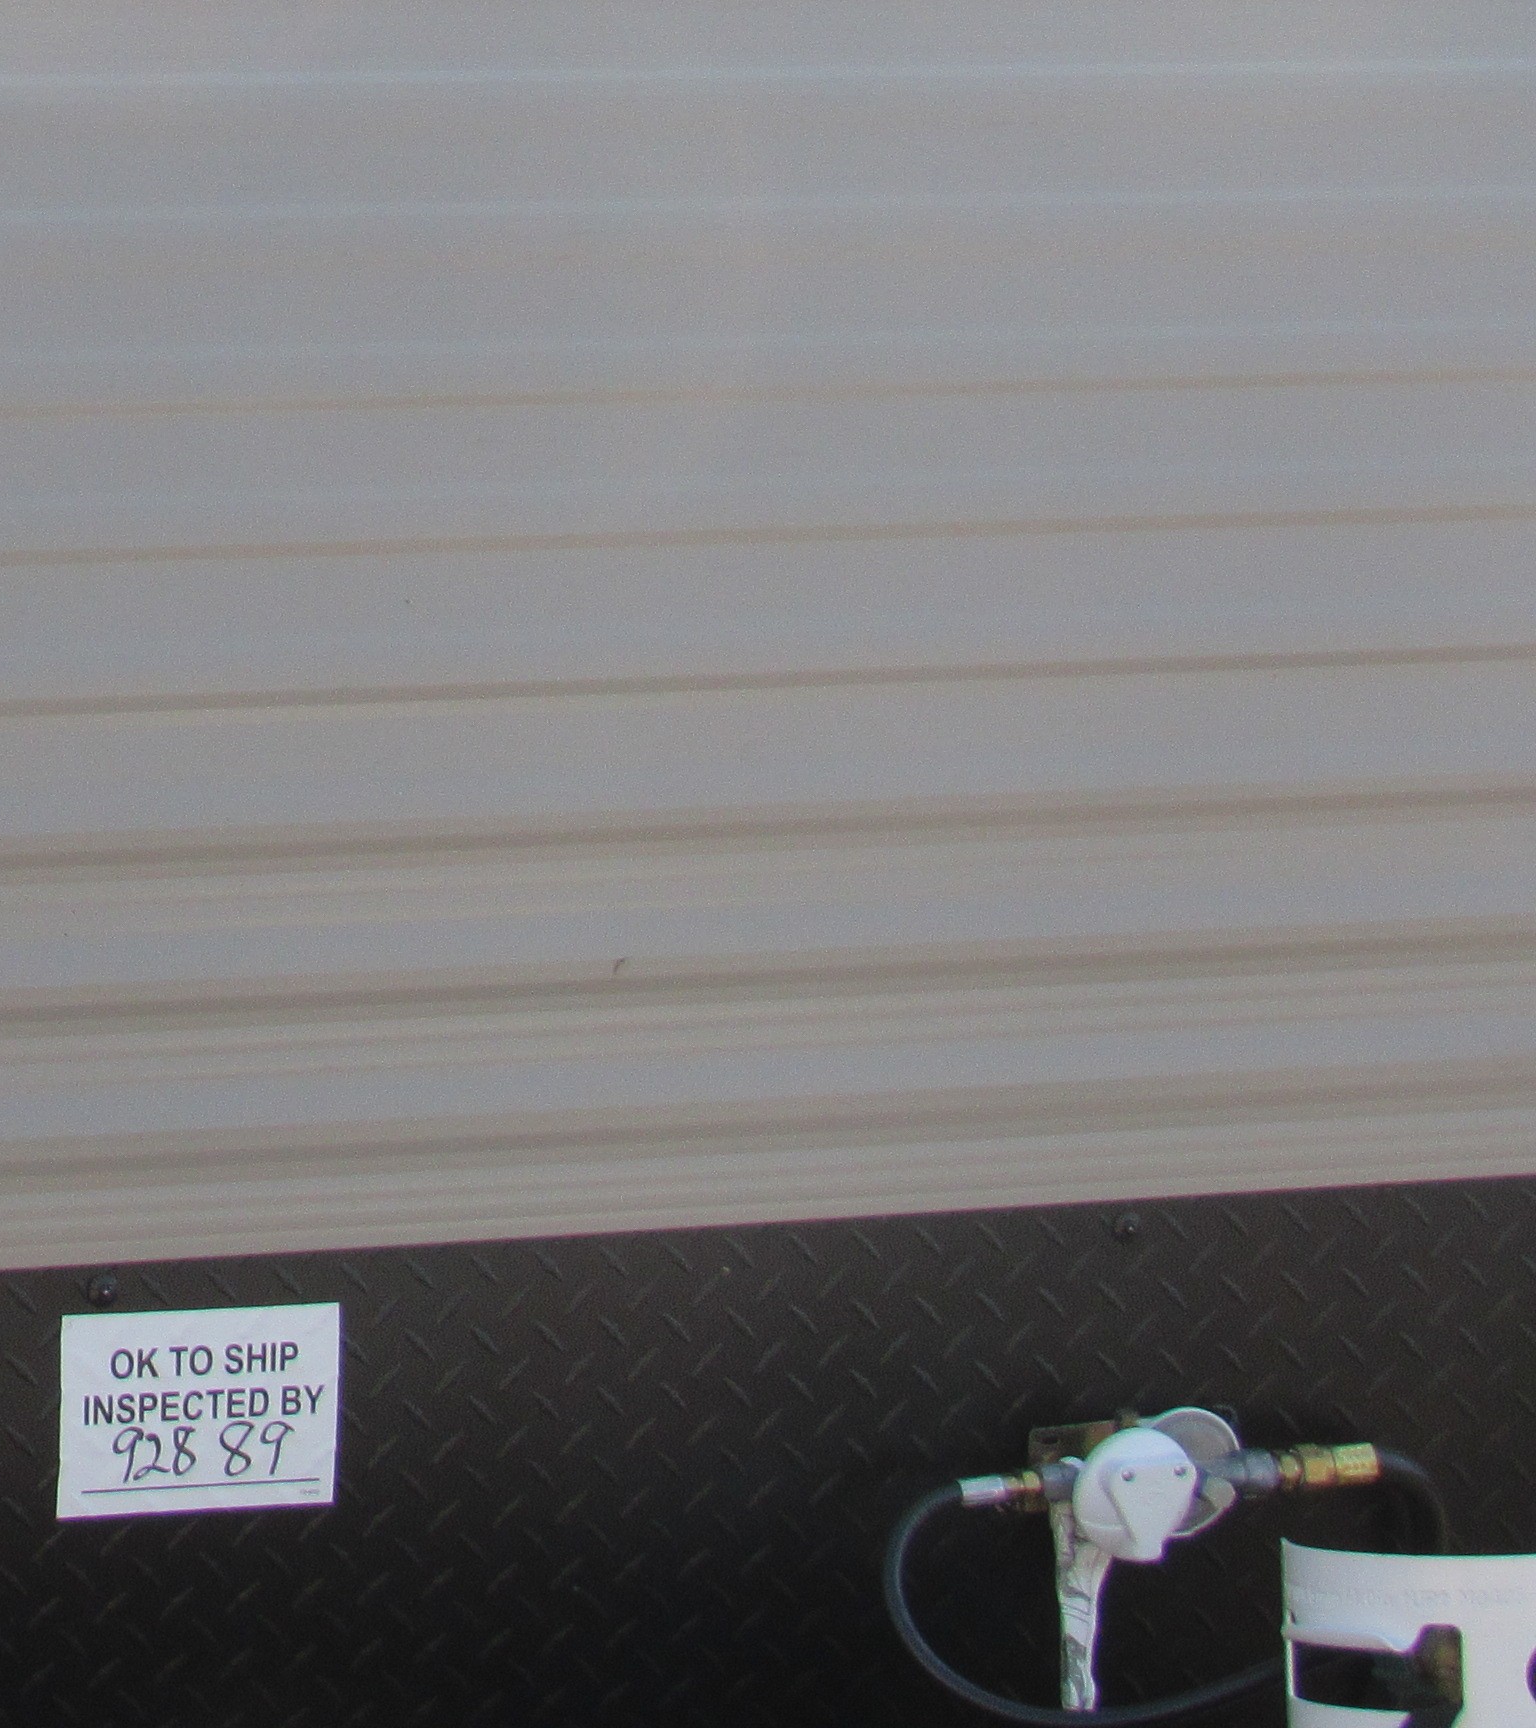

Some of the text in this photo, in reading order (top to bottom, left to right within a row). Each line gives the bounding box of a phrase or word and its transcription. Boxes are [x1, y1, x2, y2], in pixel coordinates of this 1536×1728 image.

[110, 1341, 299, 1379] OK TO SHIP
[83, 1384, 325, 1425] INSPECTED BY
